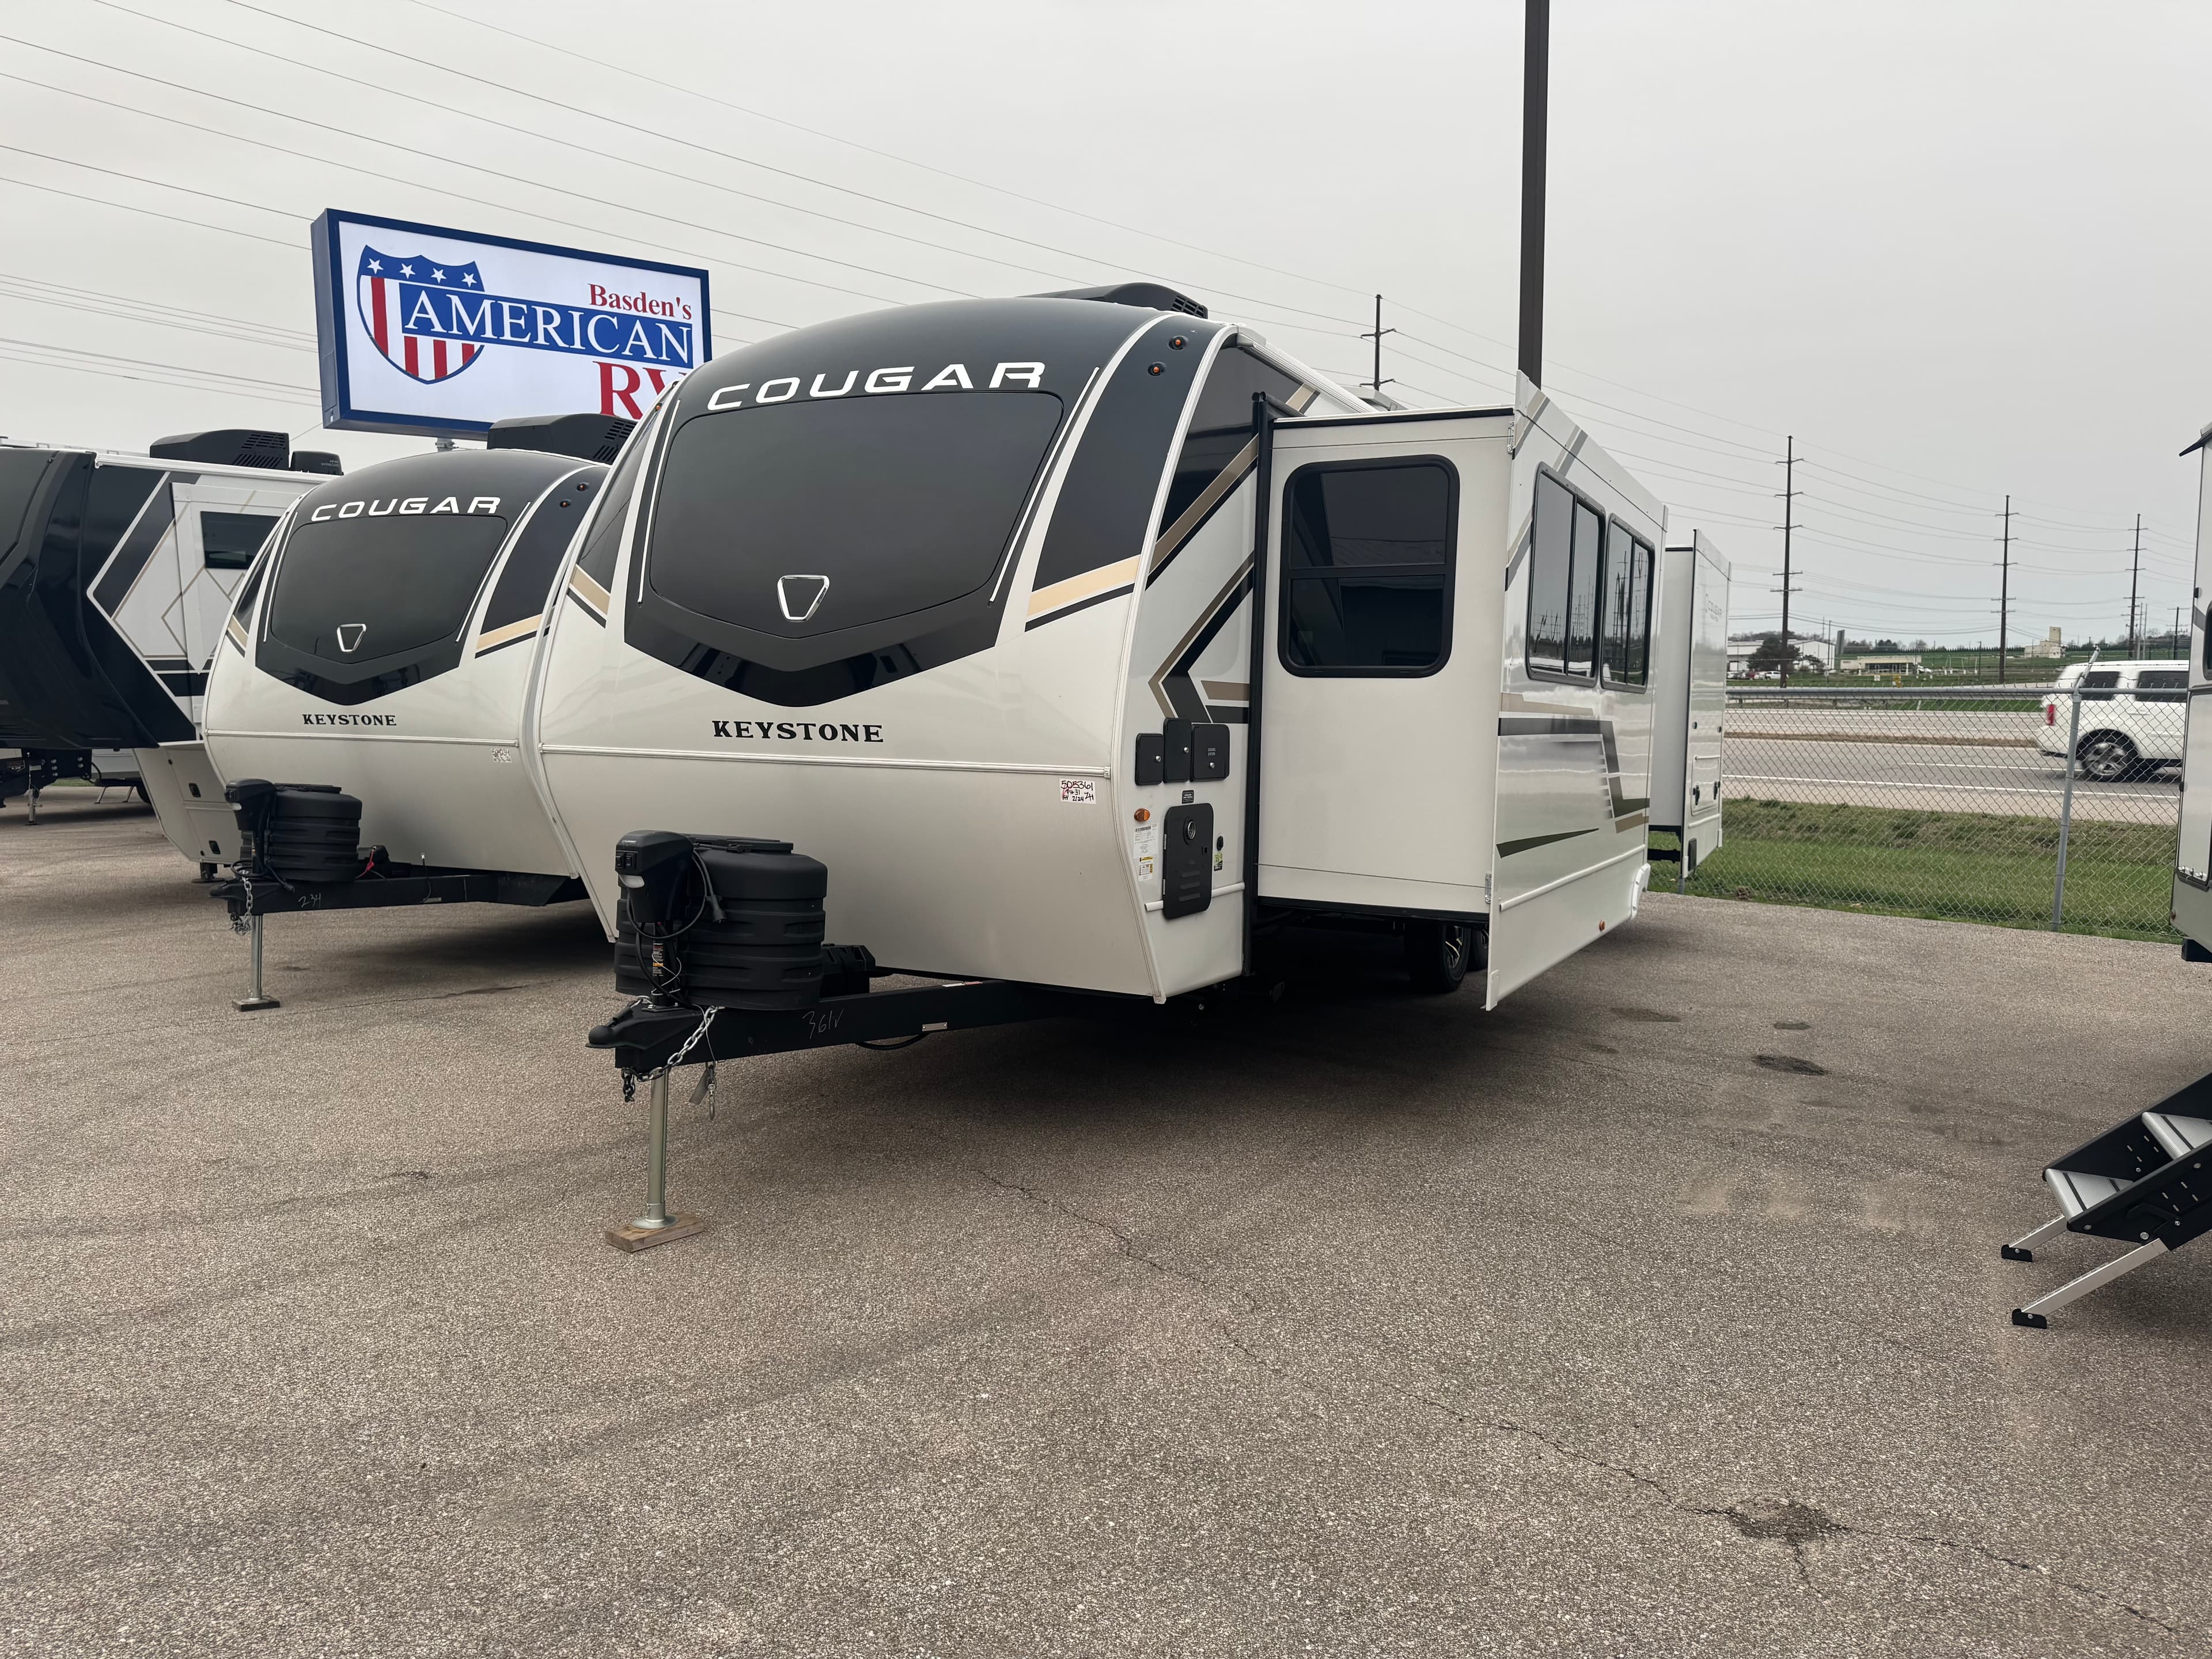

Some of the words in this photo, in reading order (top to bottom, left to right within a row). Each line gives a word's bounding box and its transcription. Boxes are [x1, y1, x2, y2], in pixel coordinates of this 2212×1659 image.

[588, 283, 691, 320] Basden's
[404, 290, 691, 364] AMERICAN
[707, 361, 1046, 411] COUGAR
[311, 497, 501, 522] COUGAR
[301, 714, 397, 726] KEYSTONE
[711, 720, 884, 743] KEYSTONE
[1060, 780, 1093, 791] 505361
[298, 892, 321, 908] 234
